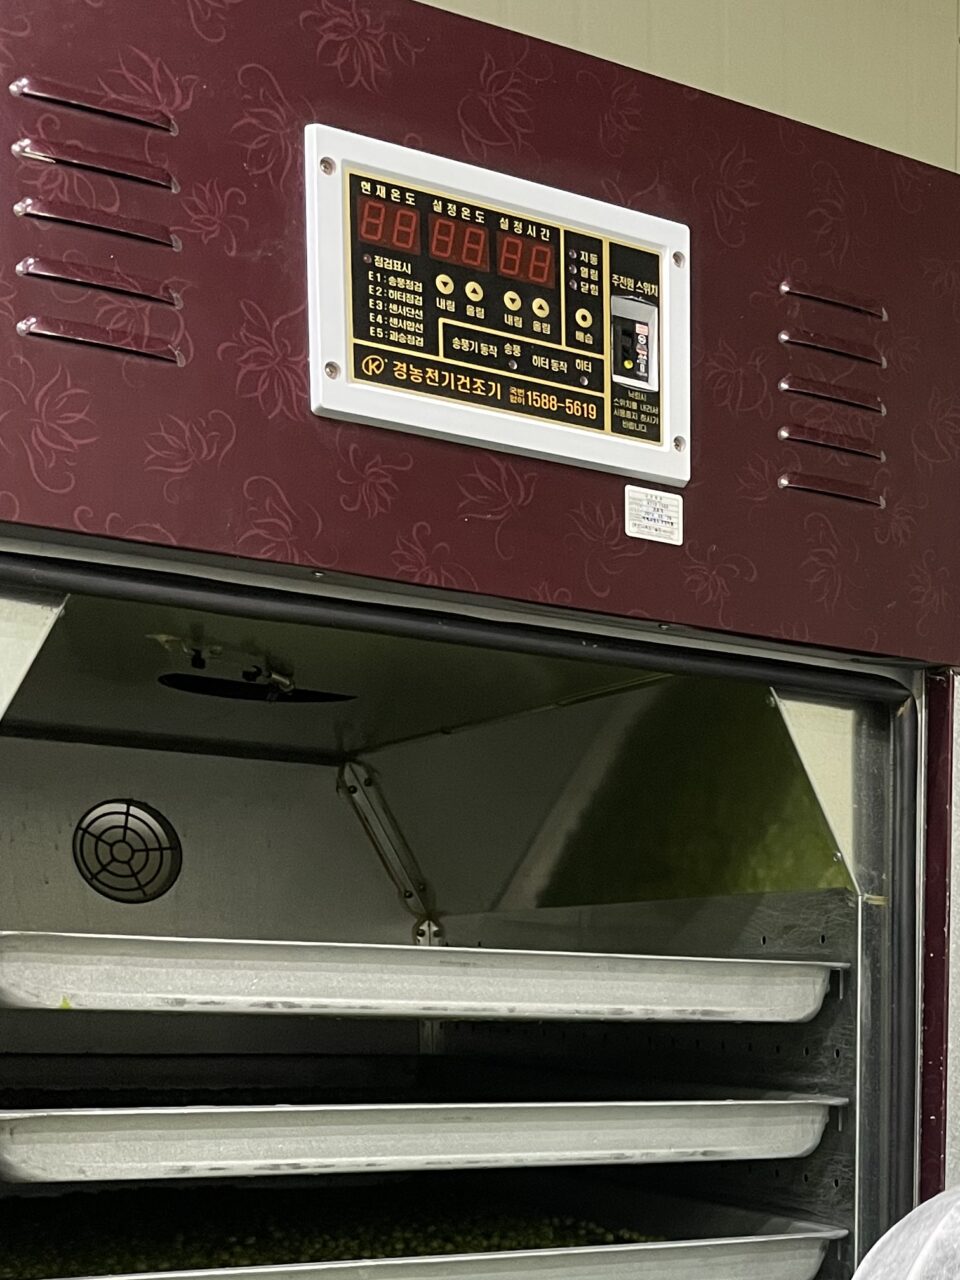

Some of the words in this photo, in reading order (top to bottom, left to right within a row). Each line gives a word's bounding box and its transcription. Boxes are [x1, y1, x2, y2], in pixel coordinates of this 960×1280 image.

[361, 181, 415, 206] 현재온도
[433, 199, 485, 223] 설정온도
[500, 217, 550, 241] 설정시간
[374, 255, 412, 275] 점검표시
[635, 280, 659, 298] 스위치
[436, 297, 456, 312] 내림
[504, 313, 523, 328] 내림
[575, 359, 592, 373] 히터
[392, 360, 502, 400] 경농전기건조기
[526, 390, 597, 420] 1588-5619
